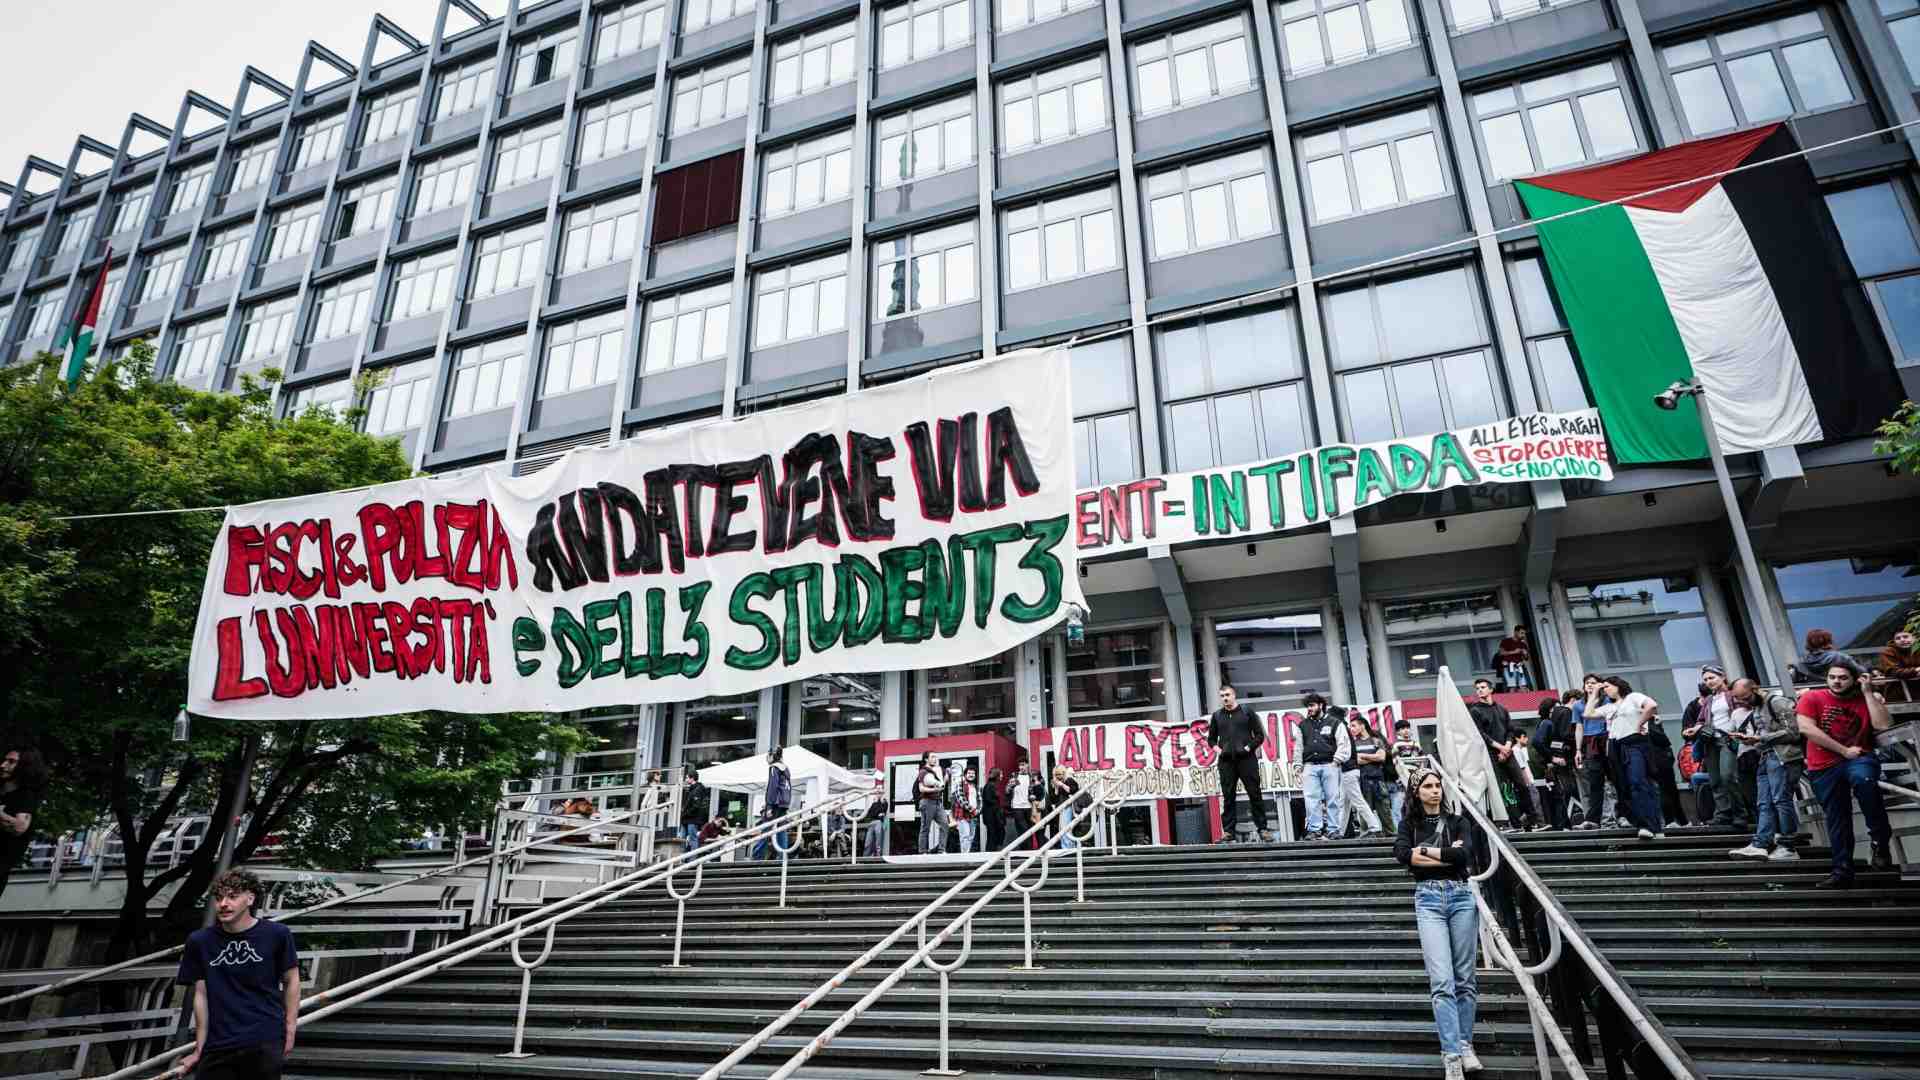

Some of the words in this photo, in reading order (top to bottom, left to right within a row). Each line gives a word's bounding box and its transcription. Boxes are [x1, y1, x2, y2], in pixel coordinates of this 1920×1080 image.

[1470, 425, 1504, 447] ALL
[1509, 414, 1549, 440] EYES
[335, 533, 369, 587] &
[526, 430, 896, 593] ANDATEVENE
[904, 406, 1040, 523] VIA
[551, 580, 712, 689] DELL3
[724, 513, 1070, 670] STUDENT3
[1058, 726, 1115, 772] ALL
[1125, 719, 1217, 770] EYES
